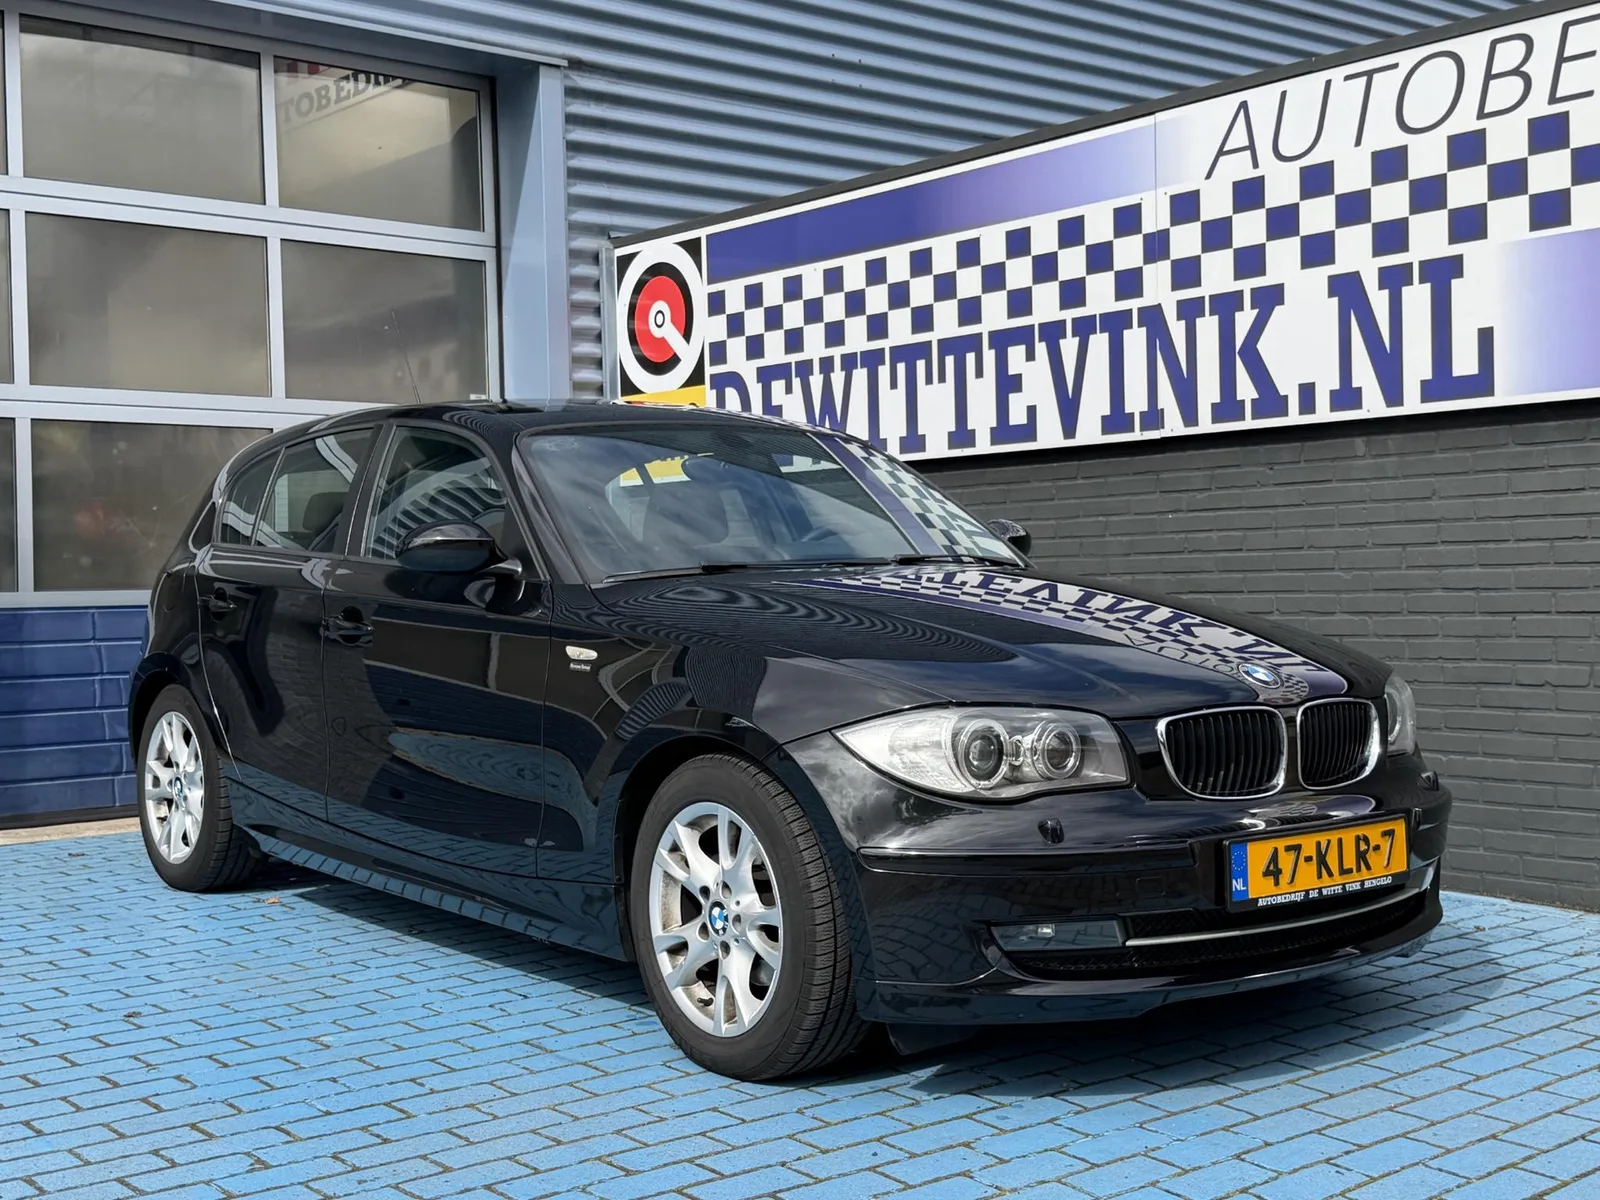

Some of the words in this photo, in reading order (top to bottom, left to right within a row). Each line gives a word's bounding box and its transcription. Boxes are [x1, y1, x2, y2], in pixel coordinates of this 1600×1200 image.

[1204, 13, 1600, 180] AUTOBE
[1262, 828, 1396, 887] 47-KLR-7
[1231, 878, 1247, 892] NL
[1257, 891, 1305, 907] AUTOBEDRIJF
[1309, 888, 1319, 898] DE
[1322, 885, 1343, 896] WITTE
[1345, 882, 1361, 892] VINK
[1364, 876, 1392, 888] HENGELO
